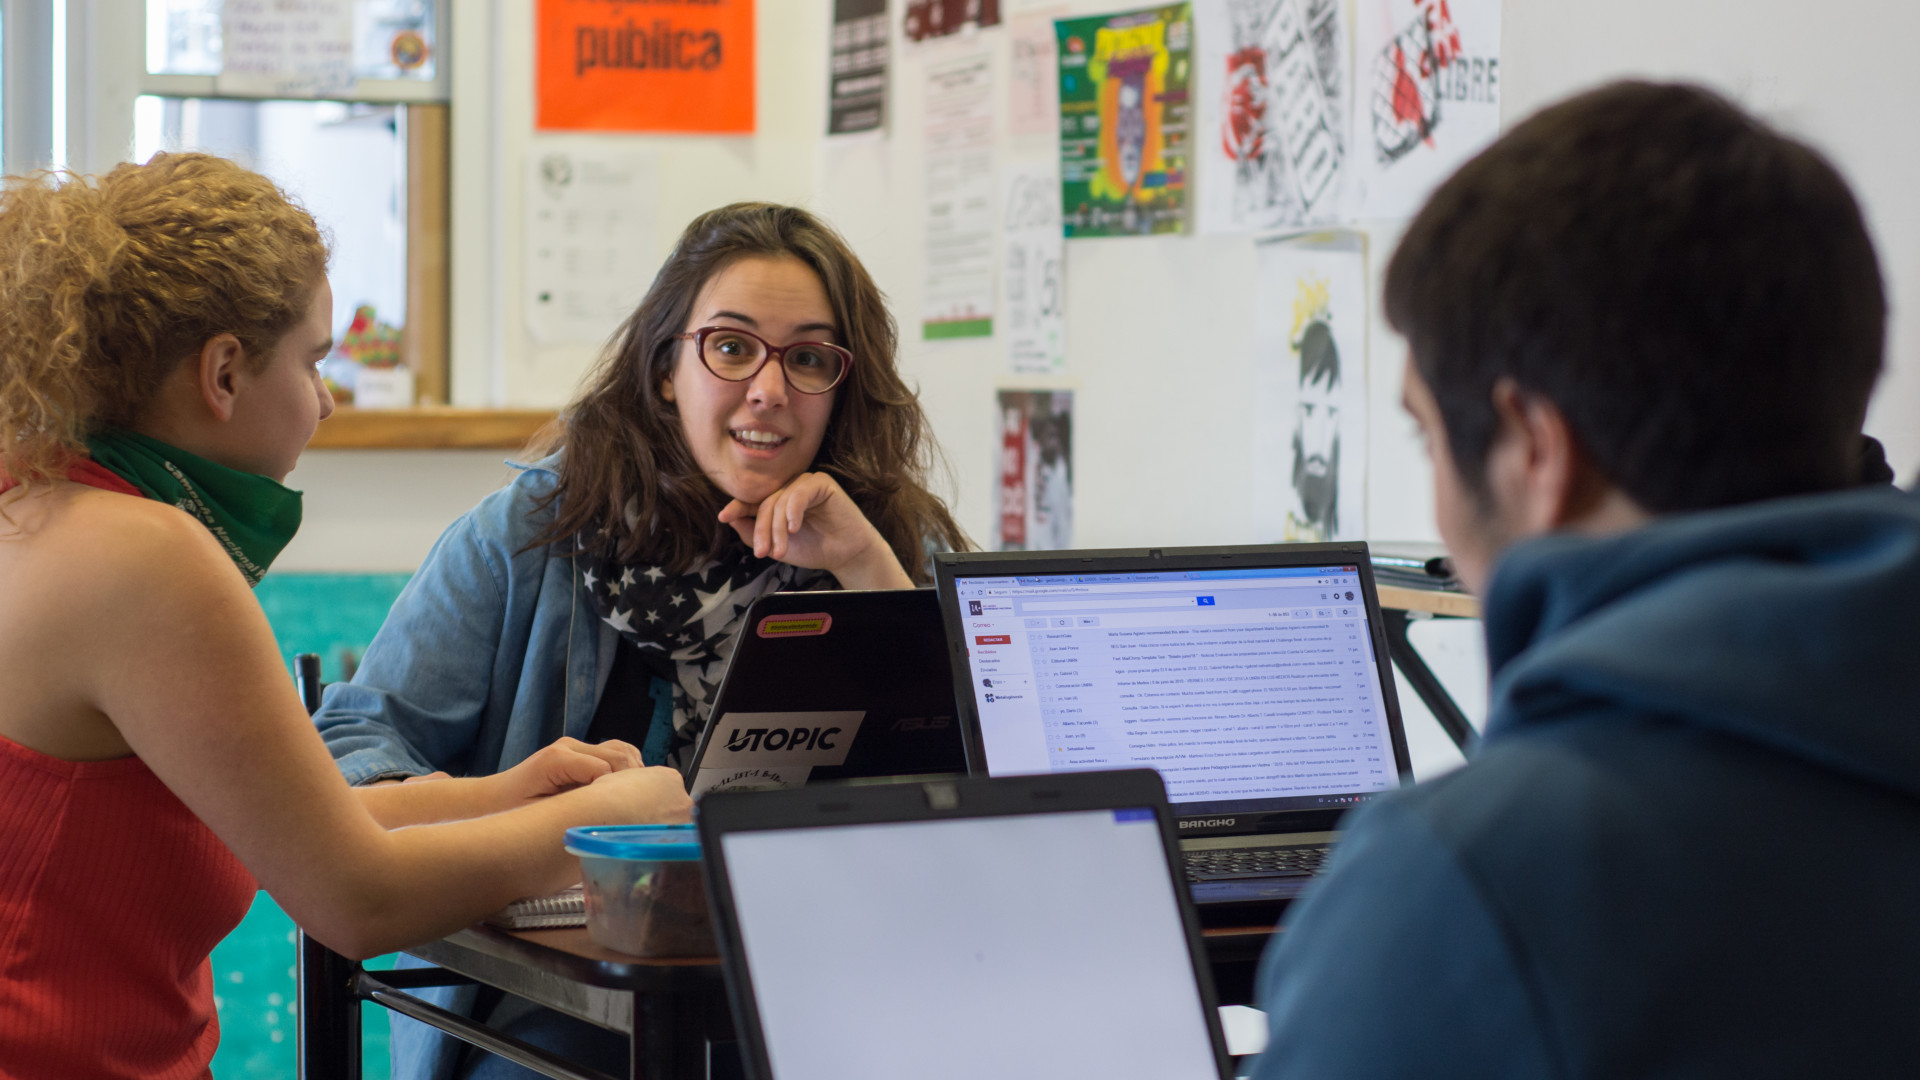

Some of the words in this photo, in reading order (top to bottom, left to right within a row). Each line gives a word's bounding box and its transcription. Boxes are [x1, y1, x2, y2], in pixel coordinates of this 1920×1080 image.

[1435, 57, 1498, 102] LIBRE
[164, 460, 216, 524] Campaña
[213, 526, 260, 572] Nacional
[724, 727, 842, 752] UTOPIC
[890, 716, 952, 731] ASUS
